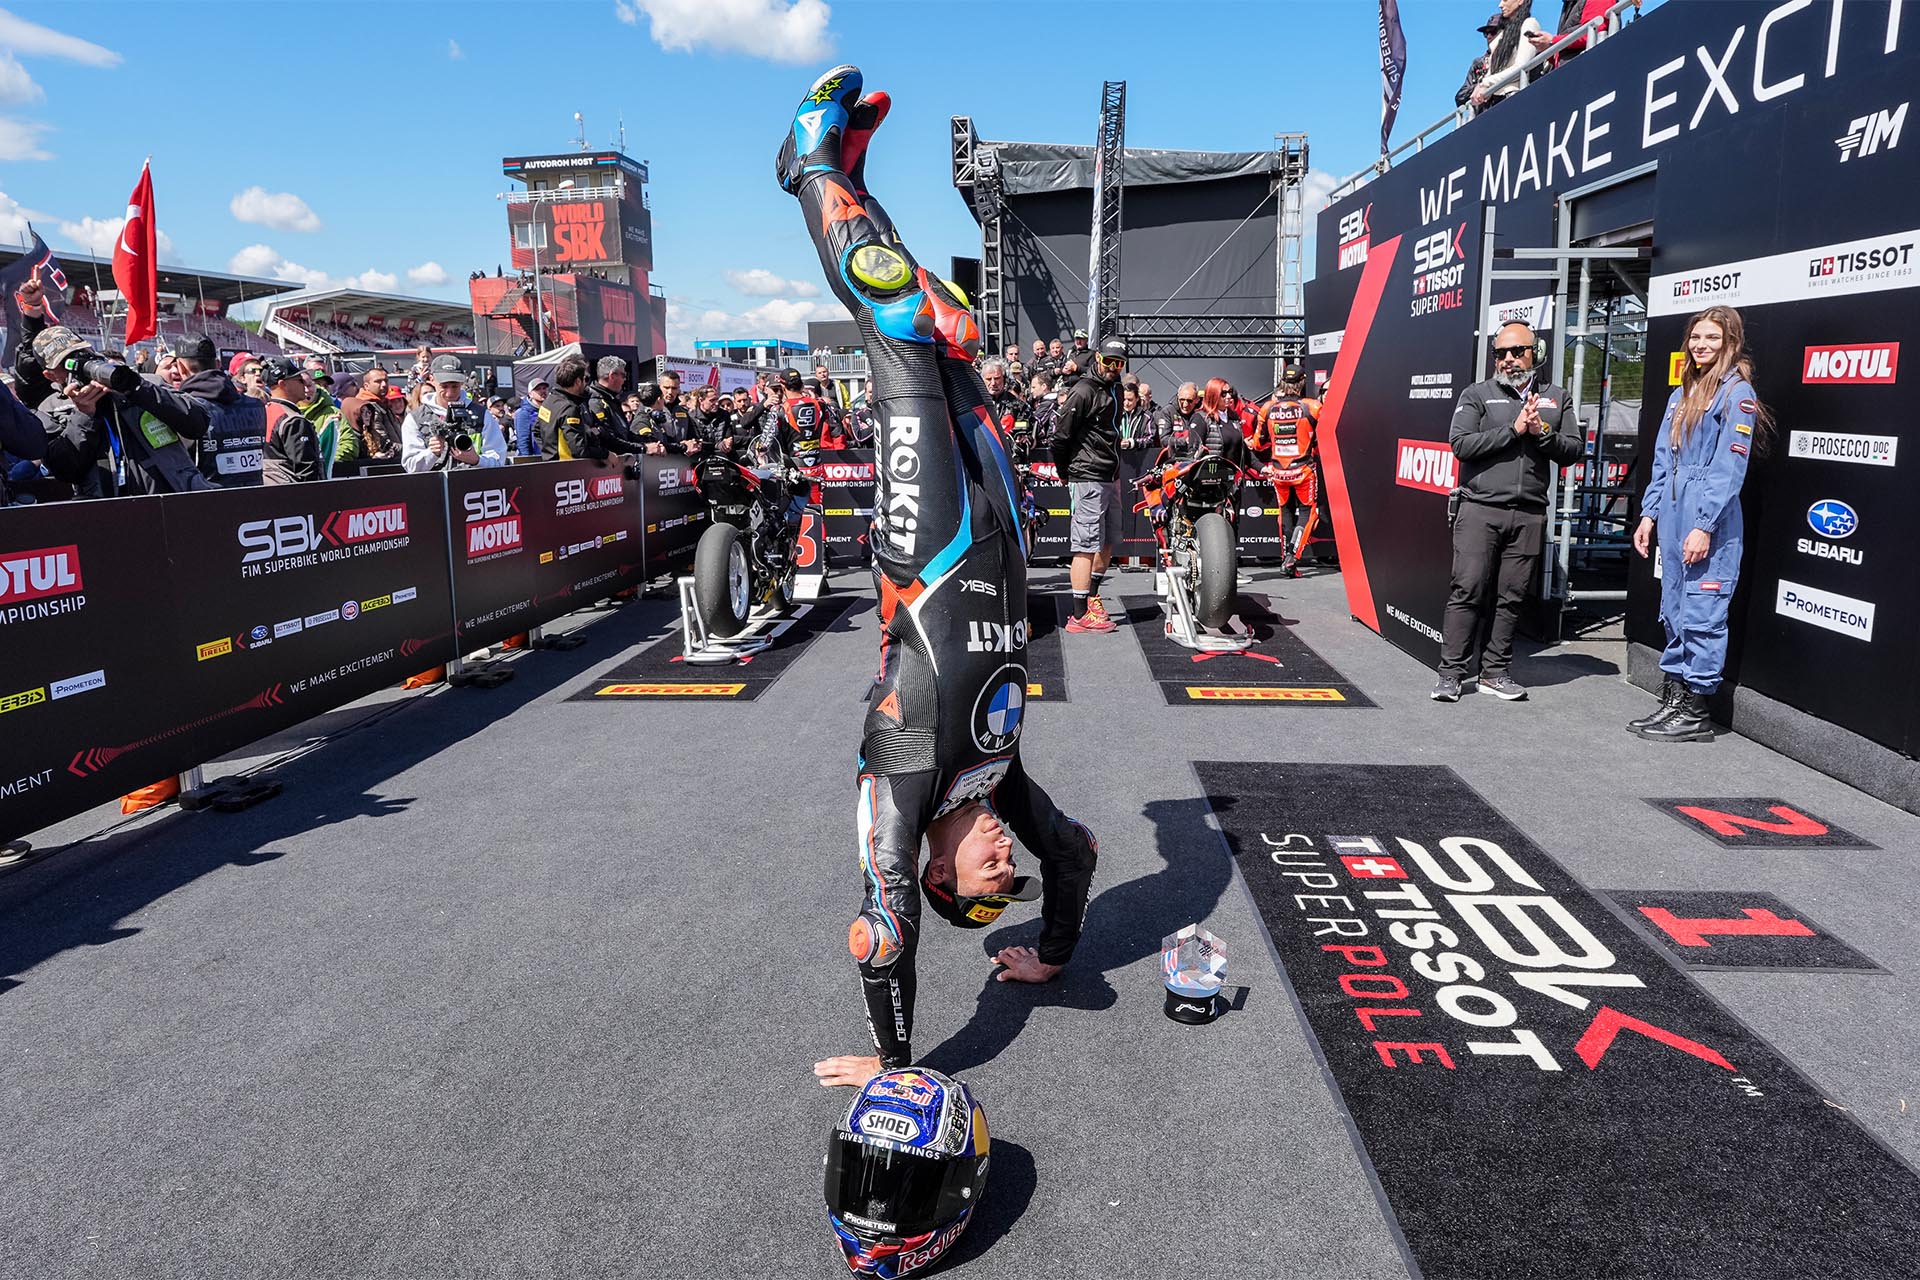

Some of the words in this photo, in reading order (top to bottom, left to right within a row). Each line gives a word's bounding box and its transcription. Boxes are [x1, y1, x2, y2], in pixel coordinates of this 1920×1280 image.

[1480, 90, 1616, 203] MAKE
[1834, 102, 1909, 162] FIM
[524, 159, 569, 170] AUTODROM
[571, 157, 594, 167] MOST
[552, 202, 605, 224] WORLD
[1339, 203, 1371, 245] SBK
[553, 222, 608, 262] SBK
[1339, 239, 1368, 270] MOTUL
[1413, 222, 1467, 275] SBK
[1837, 243, 1914, 273] TISSOT
[1426, 263, 1465, 292] TISSOT
[1692, 272, 1741, 294] TISSOT
[1831, 275, 1864, 284] WATCHES
[1867, 270, 1890, 279] SINCE
[1411, 288, 1463, 317] SUPERPOLE
[1508, 306, 1534, 319] TISSOT
[1806, 349, 1892, 379] MOTUL
[1811, 436, 1869, 459] PROSECCO
[1873, 440, 1890, 454] DOC
[1398, 446, 1455, 488] MOTUL
[463, 486, 521, 522] SBK
[555, 478, 594, 507] SBK
[597, 477, 623, 496] MOTUL
[238, 510, 340, 563] SBK
[348, 508, 406, 539] MOTUL
[469, 520, 520, 553] MOTUL
[242, 564, 262, 579] FIM
[265, 552, 318, 575] SUPERBIKE
[320, 547, 350, 564] WORLD
[353, 536, 410, 557] CHAMPIONSHIP
[1797, 538, 1864, 566] SUBARU
[476, 611, 494, 625] MAKE
[495, 600, 531, 619] EXCITEMENT
[1782, 590, 1868, 630] PROMETEON
[200, 641, 230, 658] PIRELLI
[250, 637, 272, 650] SUBARU
[362, 595, 390, 611] ACERBIS
[1410, 617, 1443, 643] EXCITEMEN
[55, 677, 104, 695] PROMETEON
[290, 680, 307, 694] WE
[309, 668, 337, 687] MAKE
[339, 648, 395, 677] EXCITEMENT
[610, 686, 734, 694] PIRELLI
[1199, 689, 1333, 699] PIRELLI
[978, 722, 1023, 749] BMW
[1675, 806, 1829, 837] 2
[1637, 906, 1817, 947] 1
[1260, 833, 1456, 1070] SUPERPOLE
[1395, 836, 1739, 1071] SBK
[1362, 884, 1563, 1071] TISSOT
[889, 978, 907, 1041] DAINESE
[867, 1084, 899, 1098] Red
[899, 1087, 934, 1106] Bull
[866, 1114, 911, 1136] SHOEI
[839, 1131, 864, 1144] GIVES
[869, 1138, 894, 1150] YOU
[899, 1143, 940, 1161] WINGS
[843, 1211, 896, 1232] PROMETEON
[897, 1232, 947, 1276] Red
